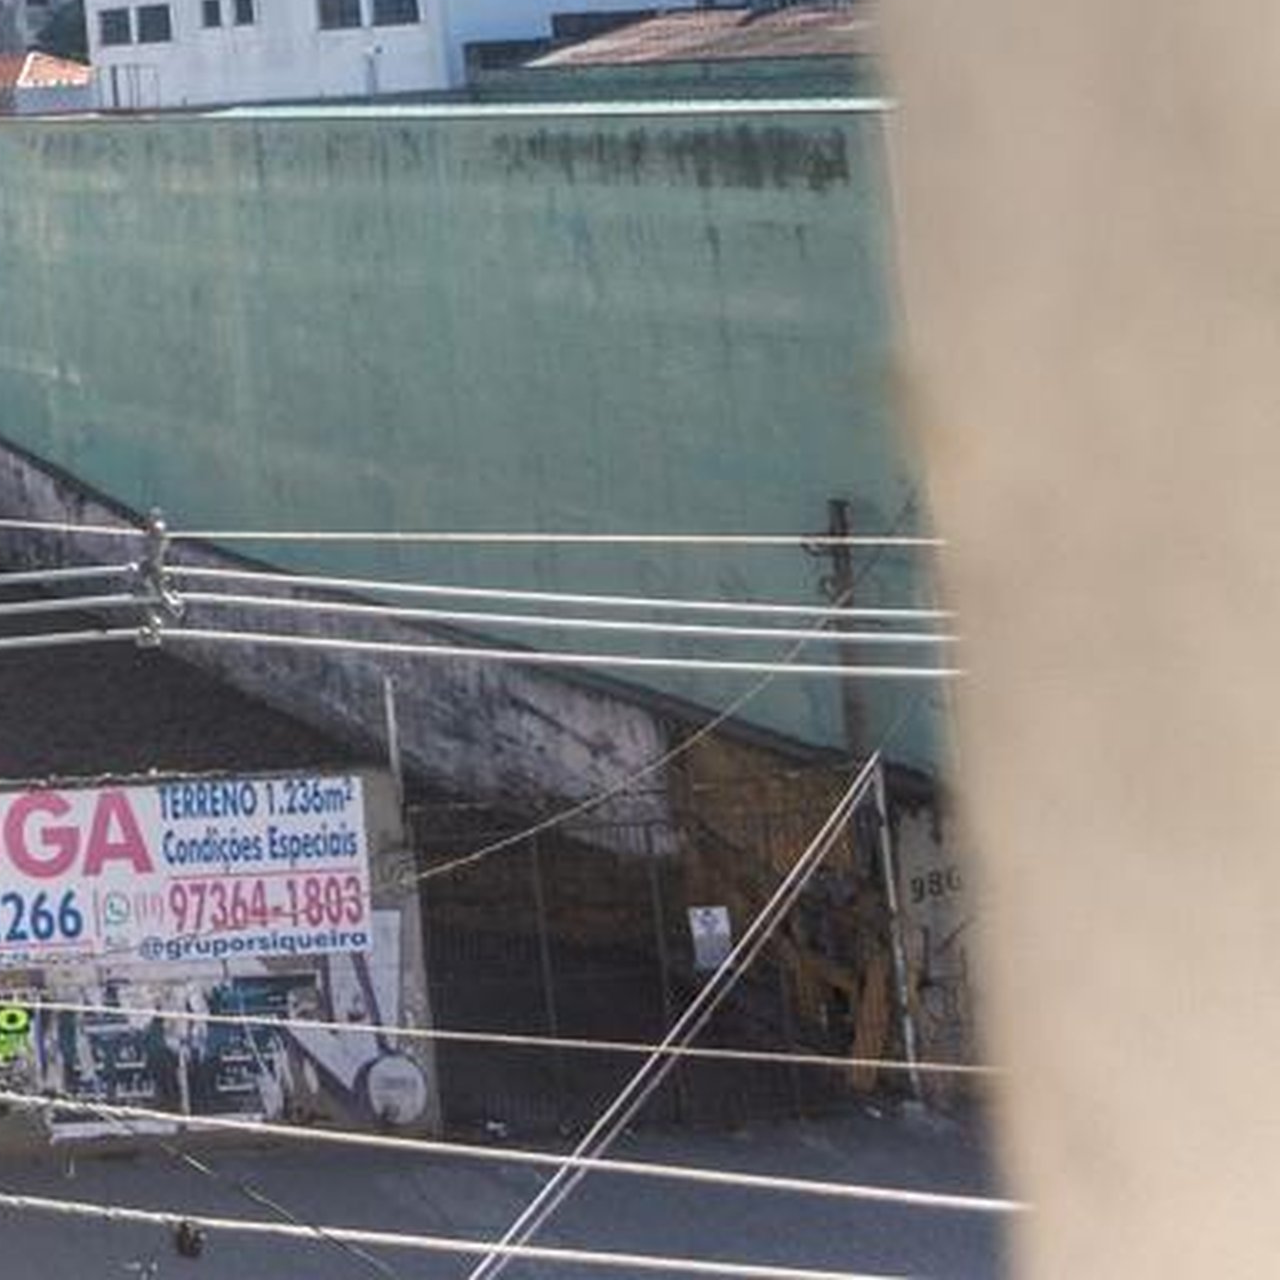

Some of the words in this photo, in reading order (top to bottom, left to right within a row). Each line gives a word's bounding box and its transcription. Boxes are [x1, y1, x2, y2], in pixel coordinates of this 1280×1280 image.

[158, 782, 257, 821] TERRENO
[162, 826, 263, 869] Condições
[268, 823, 357, 865] Especiais
[169, 875, 363, 932] 97364-1803
[140, 930, 369, 960] @gruporsiqueira
